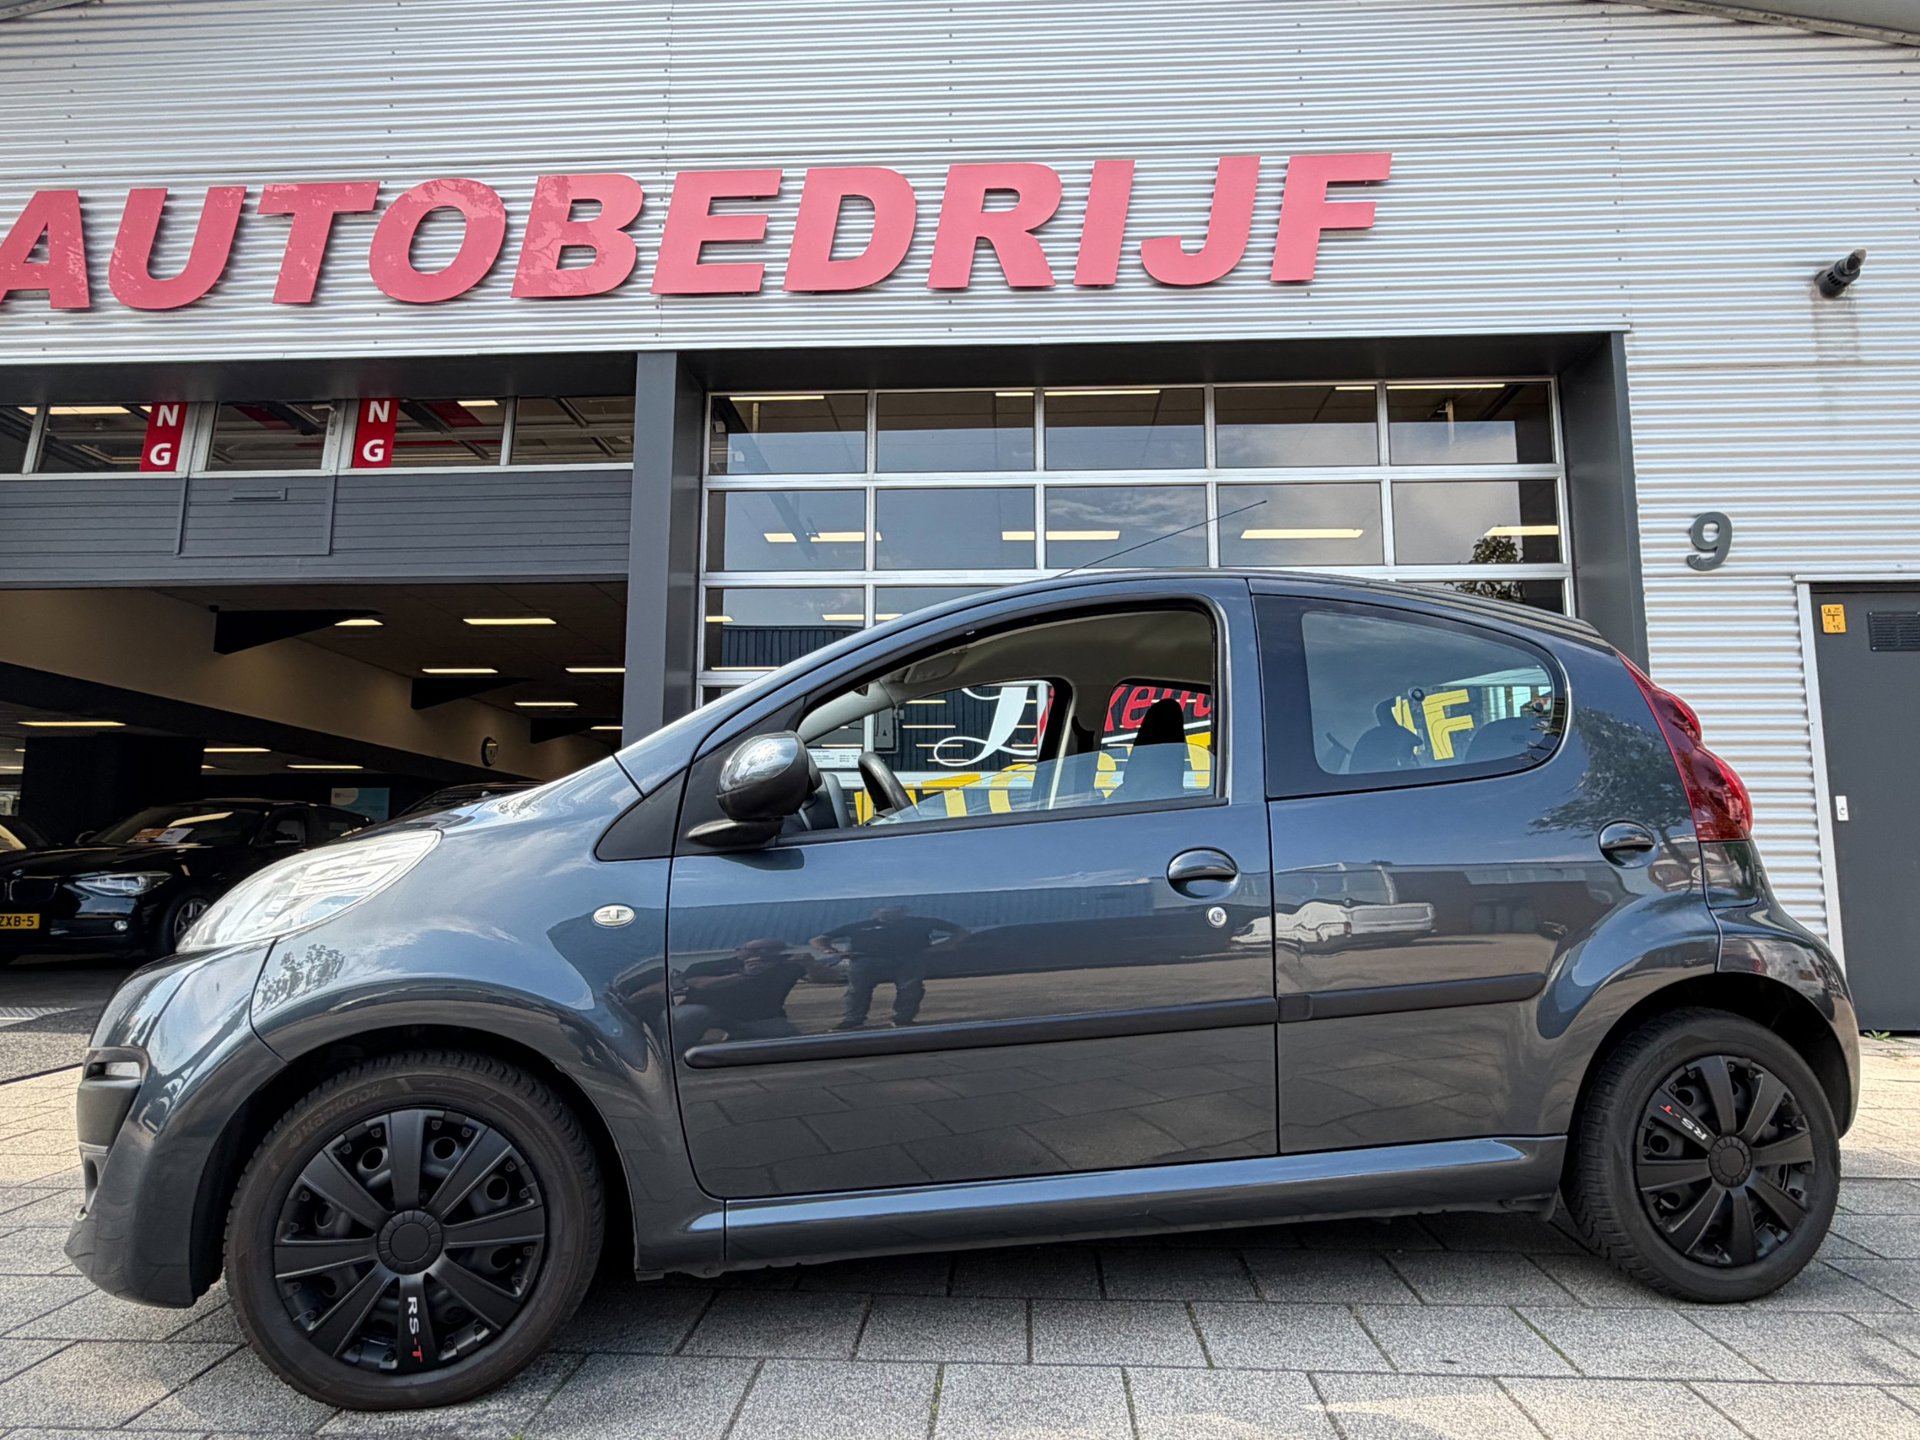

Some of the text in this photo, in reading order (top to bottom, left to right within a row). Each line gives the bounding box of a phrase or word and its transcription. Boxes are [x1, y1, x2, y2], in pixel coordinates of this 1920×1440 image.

[0, 153, 1392, 312] AUTOBEDRIJF
[1687, 511, 1732, 571] 9
[407, 1296, 423, 1362] RS-T
